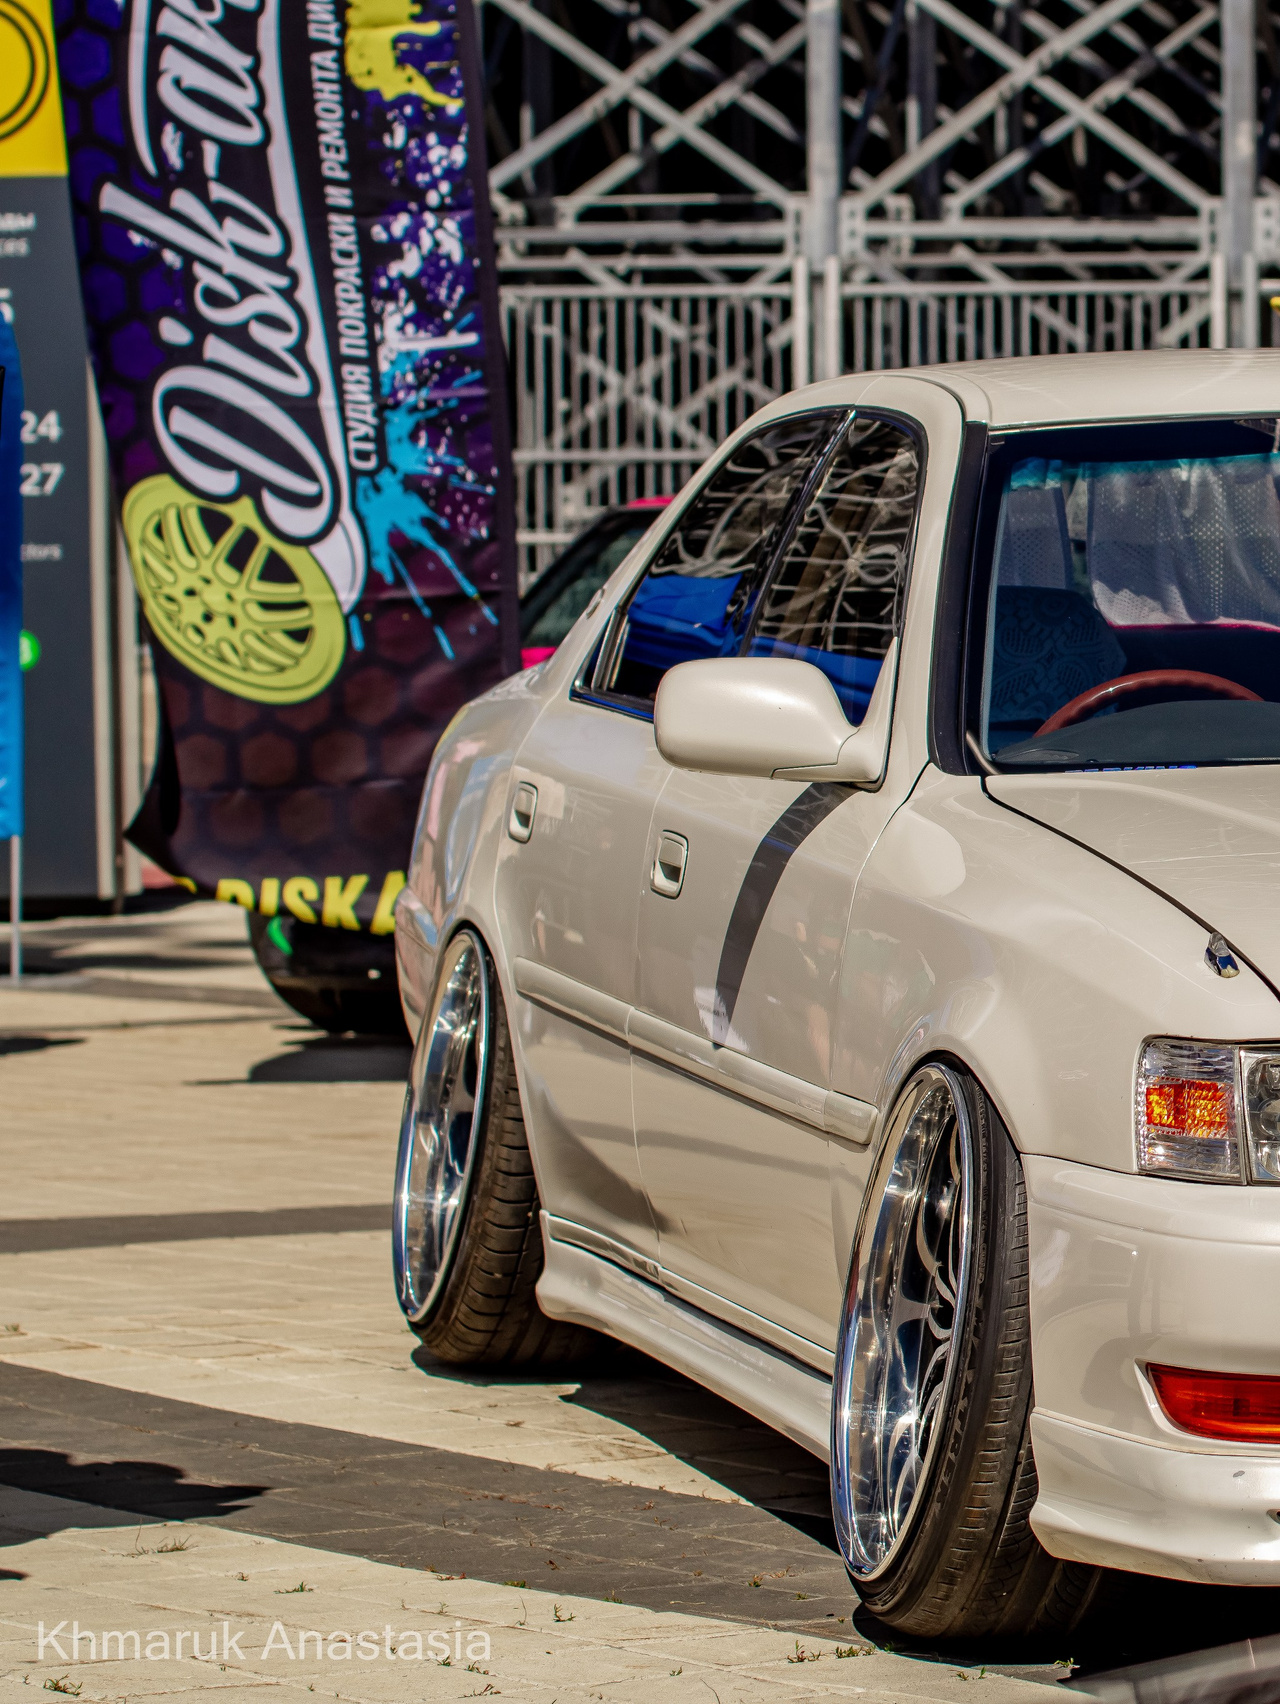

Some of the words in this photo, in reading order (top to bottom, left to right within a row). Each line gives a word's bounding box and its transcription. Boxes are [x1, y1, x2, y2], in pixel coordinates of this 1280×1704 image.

[305, 0, 342, 46] ДИ
[309, 49, 351, 182] РЕМОНТА
[324, 184, 354, 209] И
[328, 213, 369, 358] ПОКРАСКИ
[341, 363, 379, 472] СТУДИЯ
